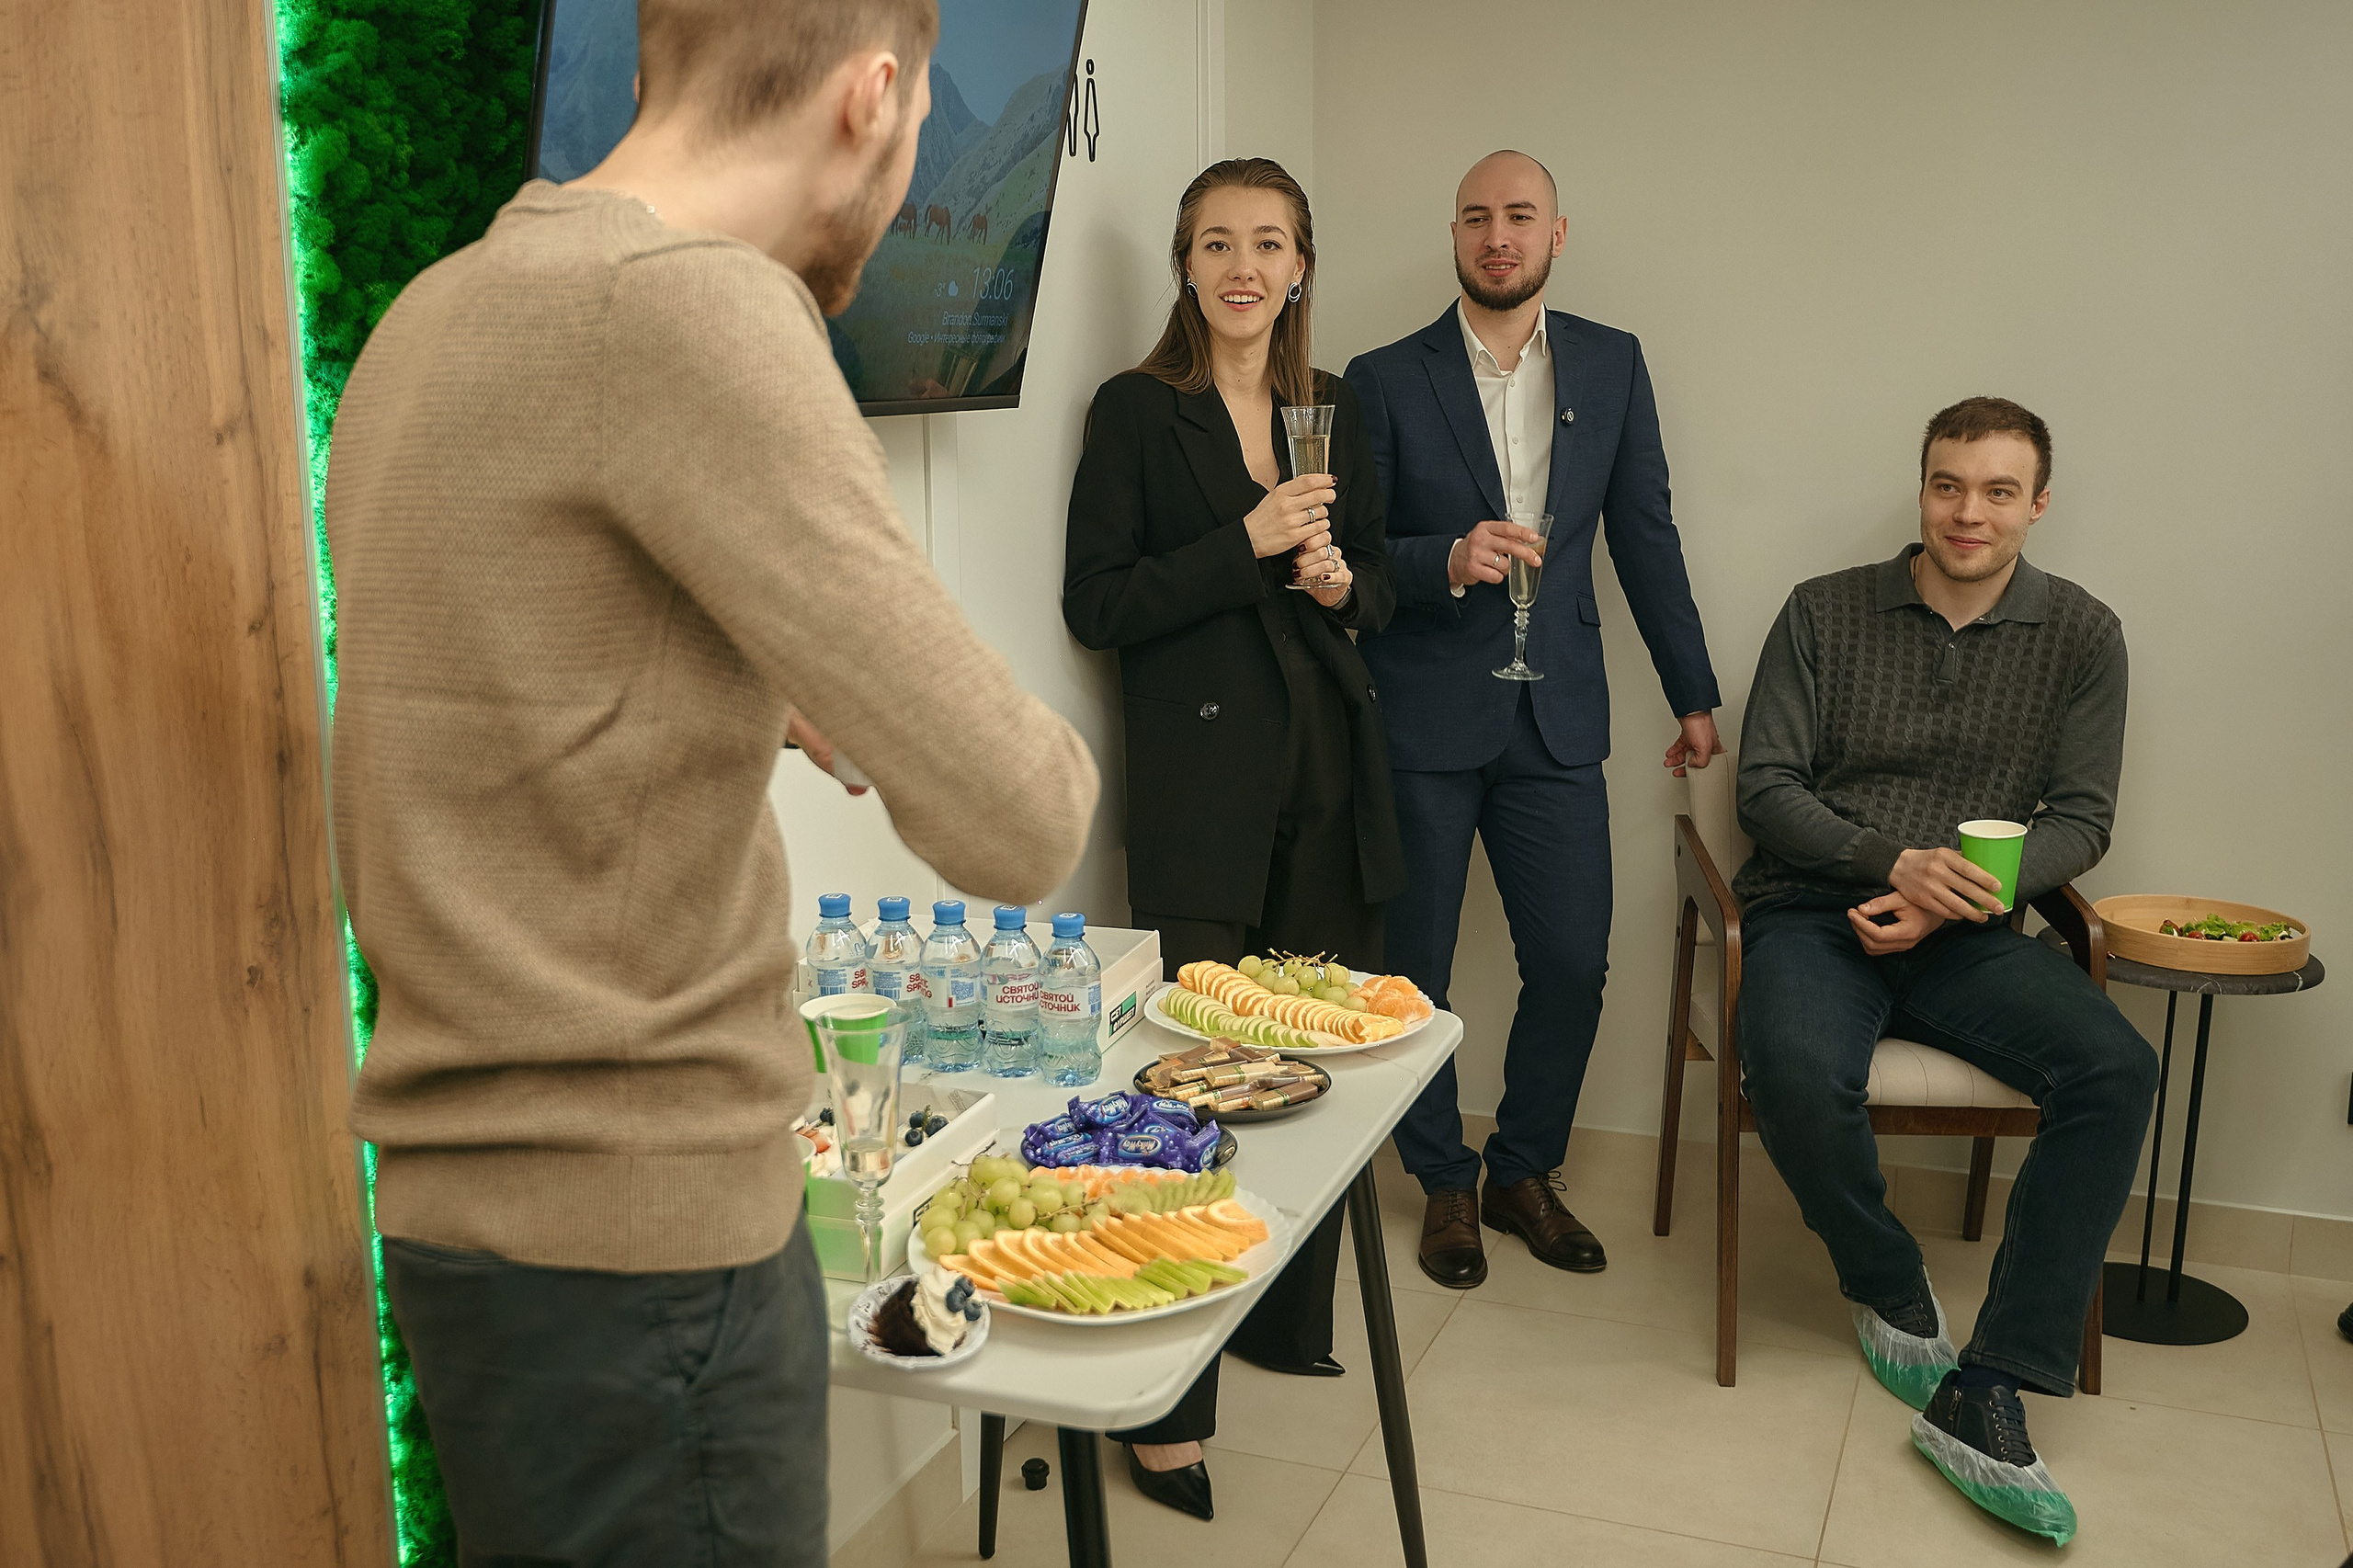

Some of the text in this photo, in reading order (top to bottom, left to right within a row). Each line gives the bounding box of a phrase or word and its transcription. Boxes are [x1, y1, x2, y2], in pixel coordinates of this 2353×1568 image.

[972, 267, 1015, 301] 13:06
[942, 311, 972, 326] Brandon
[907, 331, 930, 346] Google
[995, 994, 1040, 1004] ИСТОЧНИ
[1040, 990, 1074, 1003] СВЯТОЙ
[1039, 1000, 1081, 1012] СТОЧНИК
